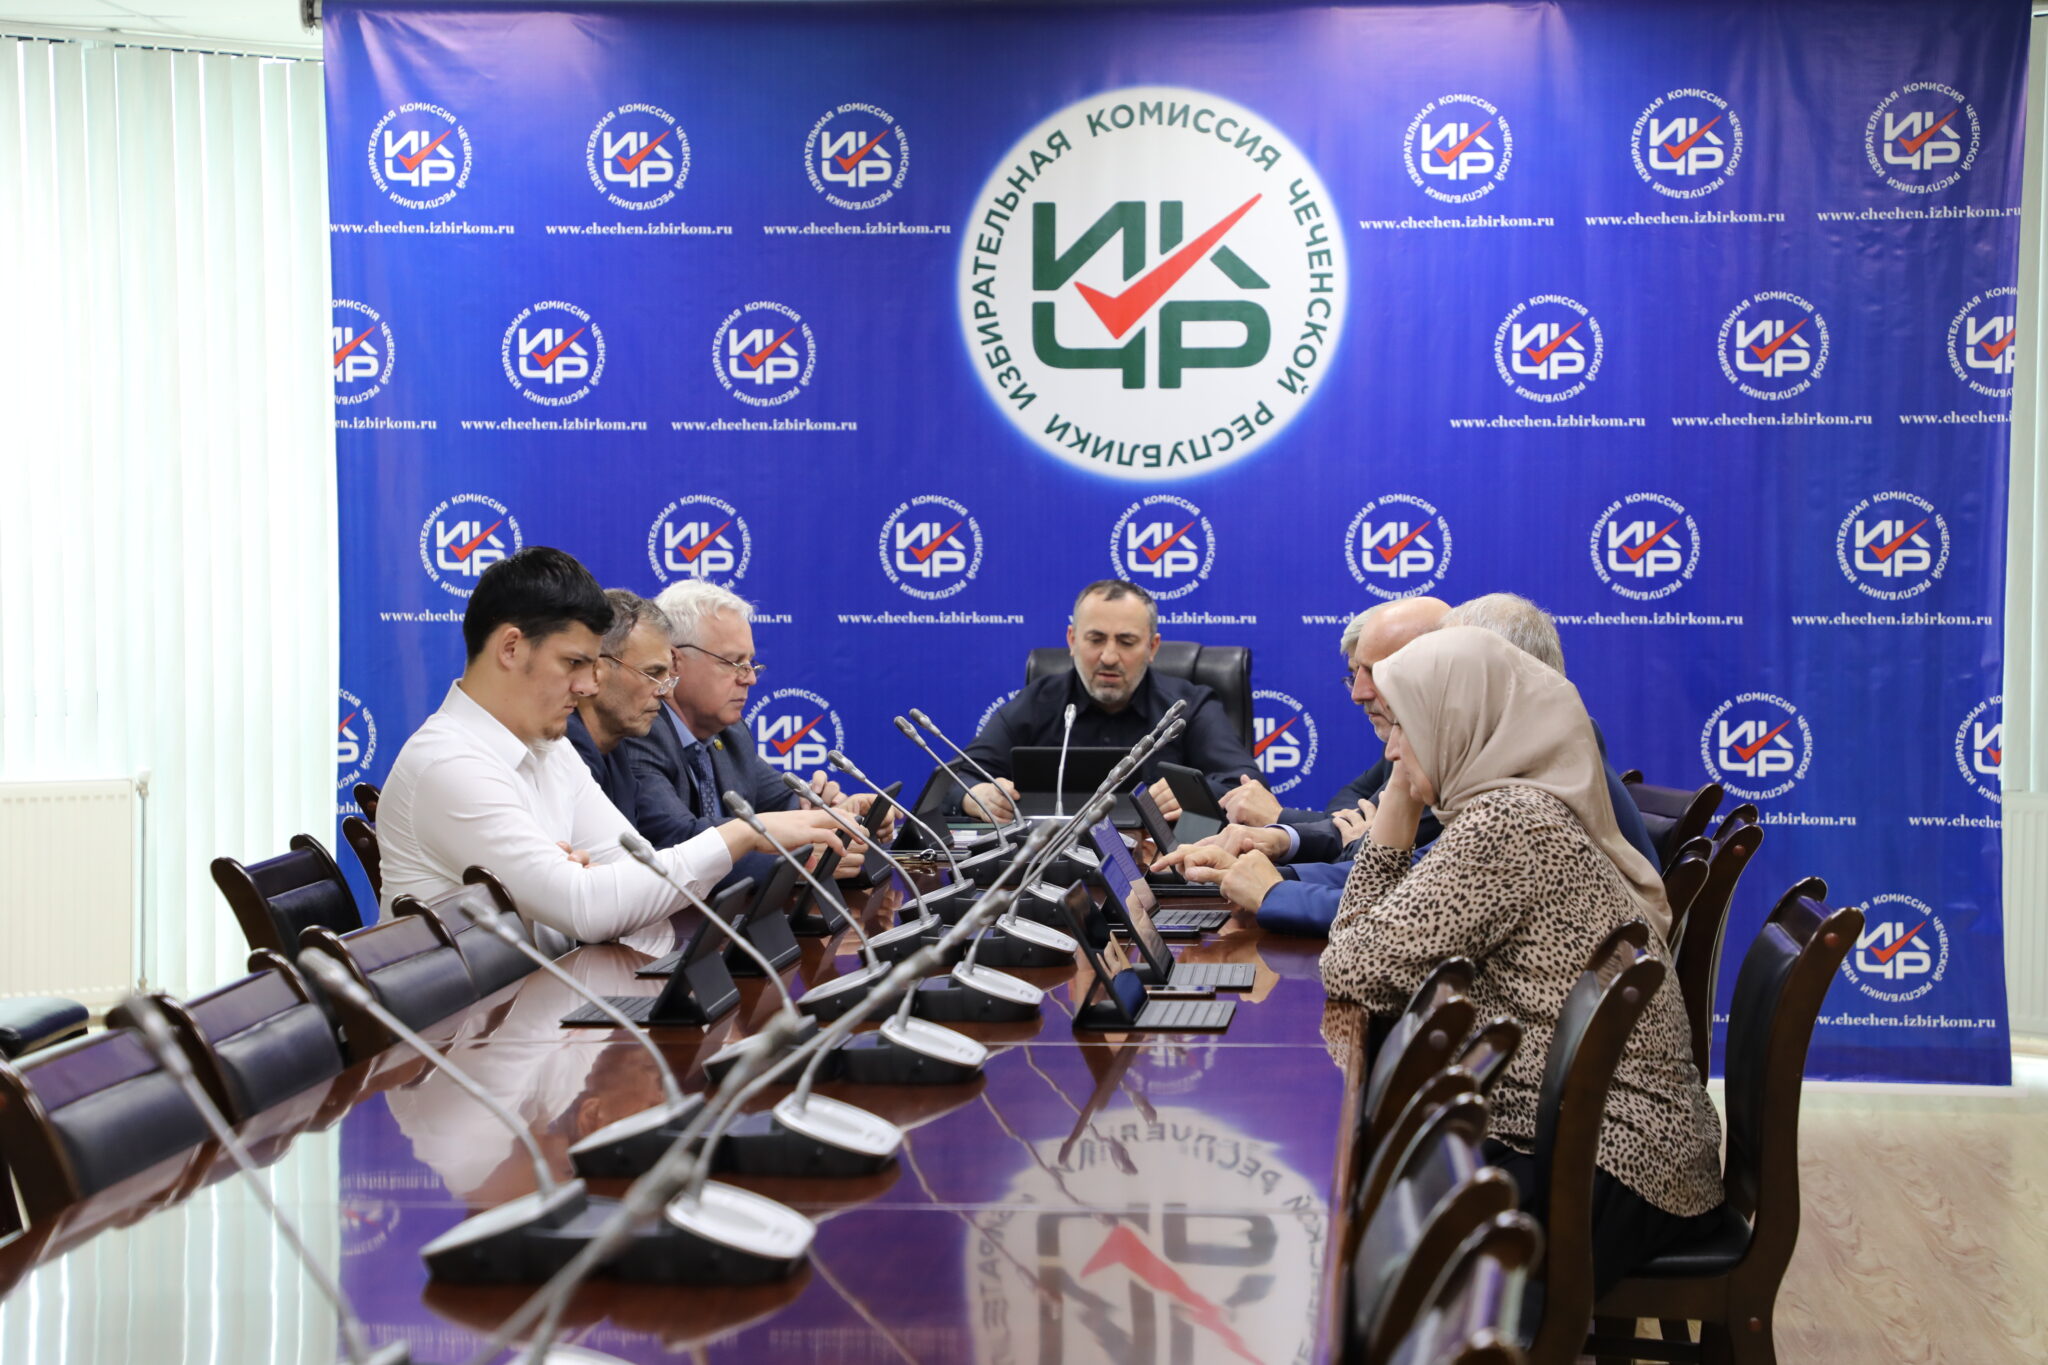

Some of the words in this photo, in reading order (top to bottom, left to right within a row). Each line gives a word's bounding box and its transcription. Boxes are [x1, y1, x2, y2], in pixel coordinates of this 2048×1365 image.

[1667, 88, 1728, 110] КОМИССИЯ
[1903, 82, 1965, 103] КОМИССИЯ
[399, 102, 457, 125] КОМИССИЯ
[618, 103, 676, 126] КОМИССИЯ
[837, 102, 894, 125] КОМИССИЯ
[1438, 93, 1498, 116] КОМИССИЯ
[1085, 101, 1282, 172] КОМИССИЯ
[1403, 102, 1436, 187] ИЗБИРАТЕЛЬНАЯ
[1630, 97, 1664, 183] ИЗБИРАТЕЛЬНАЯ
[1724, 110, 1743, 177] ЧЕЧЕНСКОЙ
[1864, 90, 1900, 178] ИЗБИРАТЕЛЬНАЯ
[1961, 104, 1980, 171] ЧЕЧЕНСКОЙ
[367, 109, 397, 193] ИЗБИРАТЕЛЬНАЯ
[455, 125, 473, 189] ЧЕЧЕНСКОЙ
[586, 111, 616, 194] ИЗБИРАТЕЛЬНАЯ
[674, 126, 691, 190] ЧЕЧЕНСКОЙ
[804, 110, 835, 194] ИЗБИРАТЕЛЬНАЯ
[892, 125, 909, 189] ЧЕЧЕНСКОЙ
[1494, 115, 1513, 181] ЧЕЧЕНСКОЙ
[1424, 181, 1495, 204] РЕСПУБЛИКИ
[1652, 176, 1725, 200] РЕСПУБЛИКИ
[1886, 171, 1961, 194] РЕСПУБЛИКИ
[389, 189, 457, 210] РЕСПУБЛИКИ
[607, 190, 675, 211] РЕСПУБЛИКИ
[825, 189, 893, 211] РЕСПУБЛИКИ
[1359, 214, 1554, 230] www.chechen.izbirkom.ru
[1585, 209, 1785, 226] www.chechen.izbirkom.ru
[1817, 205, 2021, 222] www.chechen.izbirkom.ru
[330, 220, 515, 235] www.chechen.izbirkom.ru
[545, 221, 733, 235] www.chechen.izbirkom.ru
[763, 221, 951, 235] www.chechen.izbirkom.ru
[972, 129, 1073, 411] ИЗБИРАТЕЛЬНАЯ
[1277, 177, 1334, 395] ЧЕЧЕНСКОЙ
[1985, 285, 2018, 300] КОМИ
[332, 299, 381, 322] ОМИССИЯ
[533, 300, 591, 323] КОМИССИЯ
[744, 300, 801, 323] КОМИССИЯ
[1529, 294, 1589, 317] КОМИССИЯ
[1753, 291, 1815, 313] КОМИССИЯ
[501, 307, 531, 390] ИЗБИРАТЕЛЬНАЯ
[712, 308, 742, 390] ИЗБИРАТЕЛЬНАЯ
[1494, 302, 1527, 387] ИЗБИРАТЕЛЬНАЯ
[1585, 316, 1604, 381] ЧЕЧЕНСКОЙ
[1717, 299, 1751, 384] ИЗБИРАТЕЛЬНАЯ
[1810, 313, 1830, 379] ЧЕЧЕНСКОЙ
[1947, 295, 1982, 381] ИЗБИРАТЕЛЬНАЯ
[379, 321, 396, 385] ЧЕЧЕНСКОЙ
[589, 322, 606, 386] ЧЕЧЕНСКОЙ
[799, 323, 816, 386] ЧЕЧЕНСКОЙ
[334, 385, 381, 407] РЕСПУБЛ
[523, 385, 590, 407] РЕСПУБЛИКИ
[733, 386, 800, 407] РЕСПУБЛИКИ
[1515, 381, 1586, 403] РЕСПУБЛИКИ
[1739, 379, 1811, 401] РЕСПУБЛИКИ
[1968, 378, 2014, 399] УБЛИКИ
[460, 417, 647, 431] www.chechen.izbirkom.ru
[671, 417, 858, 431] www.chechen.izbirkom.ru
[1449, 414, 1646, 428] www.chechen.izbirkom.ru
[1671, 411, 1873, 426] www.chechen.izbirkom.ru
[1899, 411, 2012, 426] www.chechen.i
[1044, 400, 1275, 468] РЕСПУБЛИКИ
[911, 494, 968, 517] КОМИССИЯ
[1624, 492, 1685, 515] КОМИССИЯ
[1872, 491, 1935, 513] КОМИССИЯ
[419, 500, 449, 582] ИЗБИРАТЕЛЬНАЯ
[451, 493, 508, 516] КОМИССИЯ
[507, 515, 523, 552] ЧЕЧЕН
[647, 501, 678, 583] ИЗБИРАТЕЛЬНАЯ
[679, 494, 737, 517] КОМИССИЯ
[734, 516, 752, 579] ЧЕЧЕНСКОЙ
[878, 502, 909, 583] ИЗБИРАТЕЛЬНАЯ
[965, 516, 983, 580] ЧЕЧЕНСКОЙ
[1142, 494, 1201, 517] КОМИССИЯ
[1198, 516, 1216, 580] ЧЕЧЕНСКОЙ
[1344, 501, 1376, 584] ИЗБИРАТЕЛЬНАЯ
[1378, 493, 1437, 516] КОМИССИЯ
[1434, 515, 1452, 580] ЧЕЧЕНСКОЙ
[1590, 500, 1622, 584] ИЗБИРАТЕЛЬНАЯ
[1682, 514, 1701, 579] ЧЕЧЕНСКОЙ
[1836, 499, 1870, 583] ИЗБИРАТЕЛЬНАЯ
[1931, 513, 1950, 579] ЧЕЧЕНСКОЙ
[899, 579, 967, 601] РЕСПУБЛИКИ
[1611, 579, 1683, 601] РЕСПУБЛИКИ
[1858, 578, 1932, 601] РЕСПУБЛИКИ
[837, 610, 1024, 624] www.chechen.izbirkom.ru
[1791, 611, 1993, 626] www.chechen.izbirkom.ru
[772, 687, 830, 710] КОМИССИЯ
[1735, 691, 1797, 715] КОМИССИЯ
[359, 707, 377, 770] ЧЕЧЕНСКОЙ
[1250, 689, 1303, 712] ОМИССИЯ
[1300, 712, 1318, 775] ЧЕЧЕНСКОЙ
[1700, 699, 1733, 783] ИЗБИРАТЕЛЬНАЯ
[1955, 701, 1987, 785] ИЗБИРАТЕЛЬНАЯ
[1794, 714, 1813, 780] ЧЕЧЕНСКОЙ
[1722, 779, 1795, 800] РЕСПУБЛИКИ
[1872, 893, 1932, 916] КОМИССИЯ
[1932, 916, 1949, 981] ЧЕЧЕНСКОЙ
[1859, 981, 1933, 1003] РЕСПУБЛИКИ
[1814, 1012, 1996, 1028] w.chechen.izbirkom.ru
